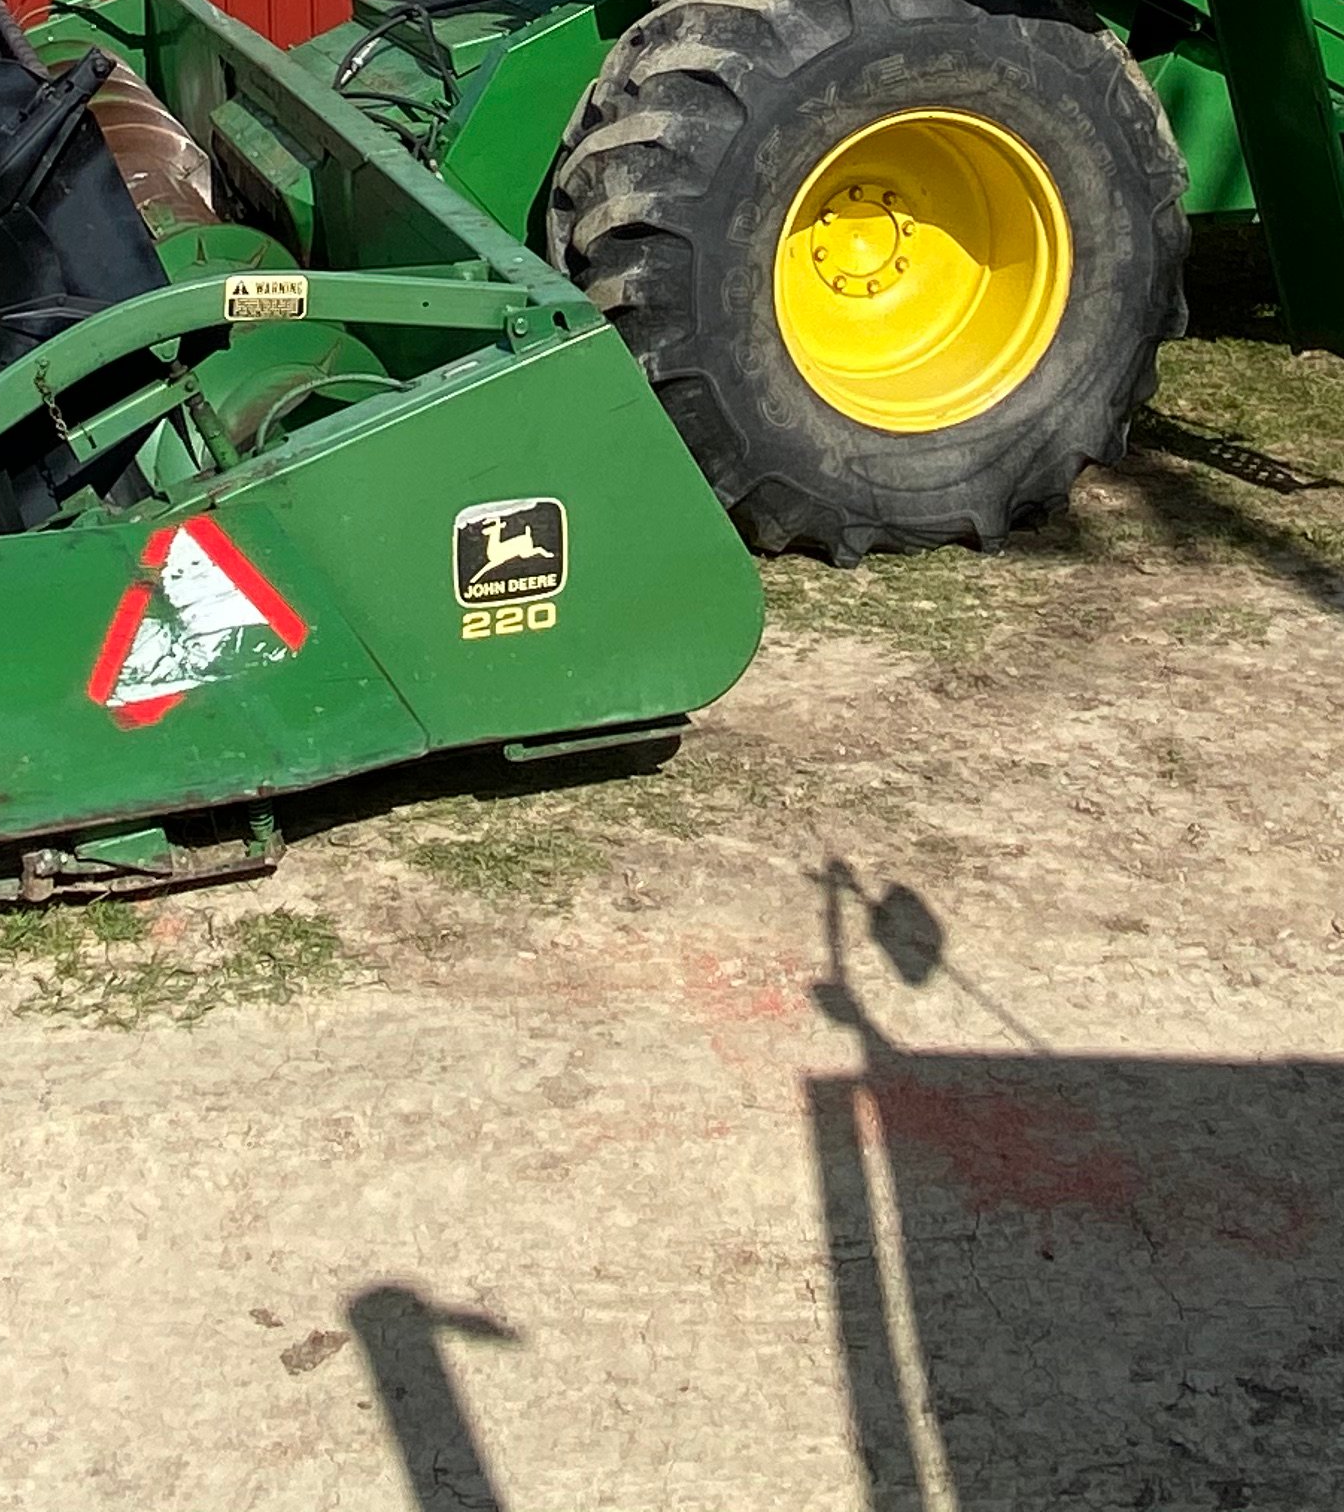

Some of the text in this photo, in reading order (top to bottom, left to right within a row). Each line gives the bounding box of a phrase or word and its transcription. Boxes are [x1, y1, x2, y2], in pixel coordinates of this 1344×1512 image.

[256, 281, 303, 296] WARNING
[463, 573, 558, 599] JOHN DEERE
[462, 602, 556, 640] 220
